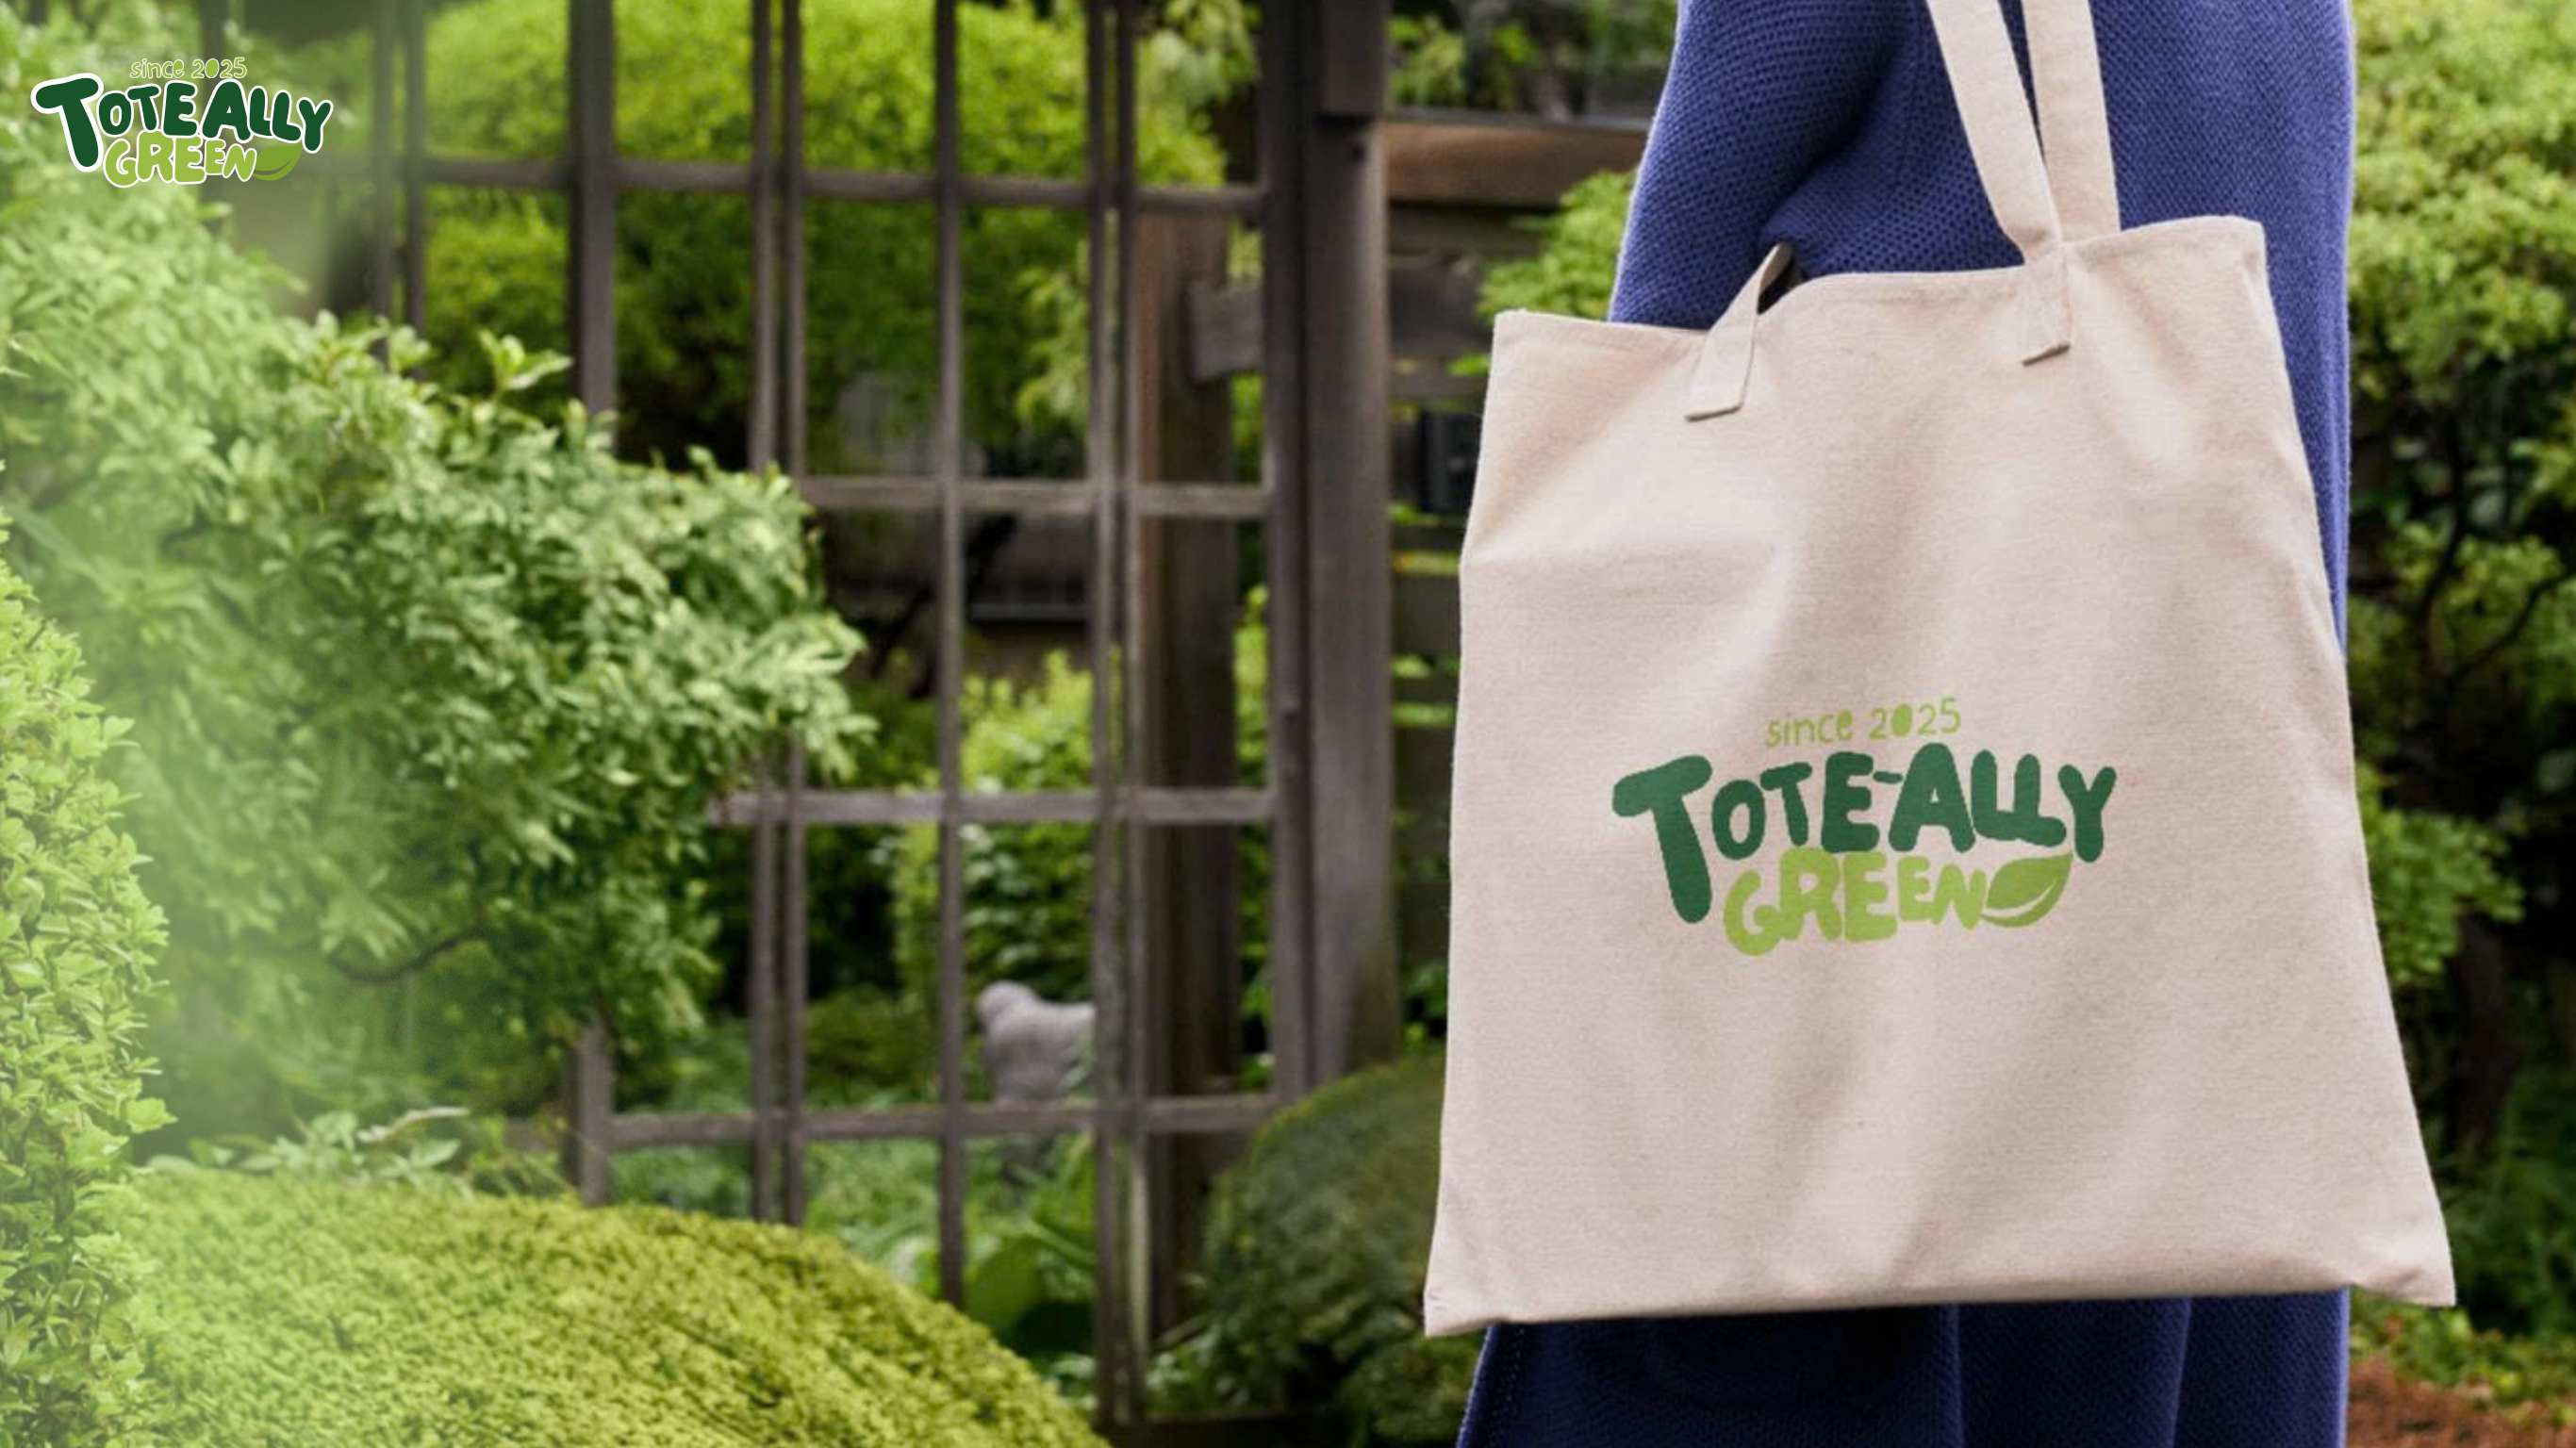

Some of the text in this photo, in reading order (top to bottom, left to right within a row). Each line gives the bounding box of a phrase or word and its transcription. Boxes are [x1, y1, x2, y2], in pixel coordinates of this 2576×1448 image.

[1765, 698, 1962, 748] since 2025
[1723, 846, 1987, 957] GREEN
